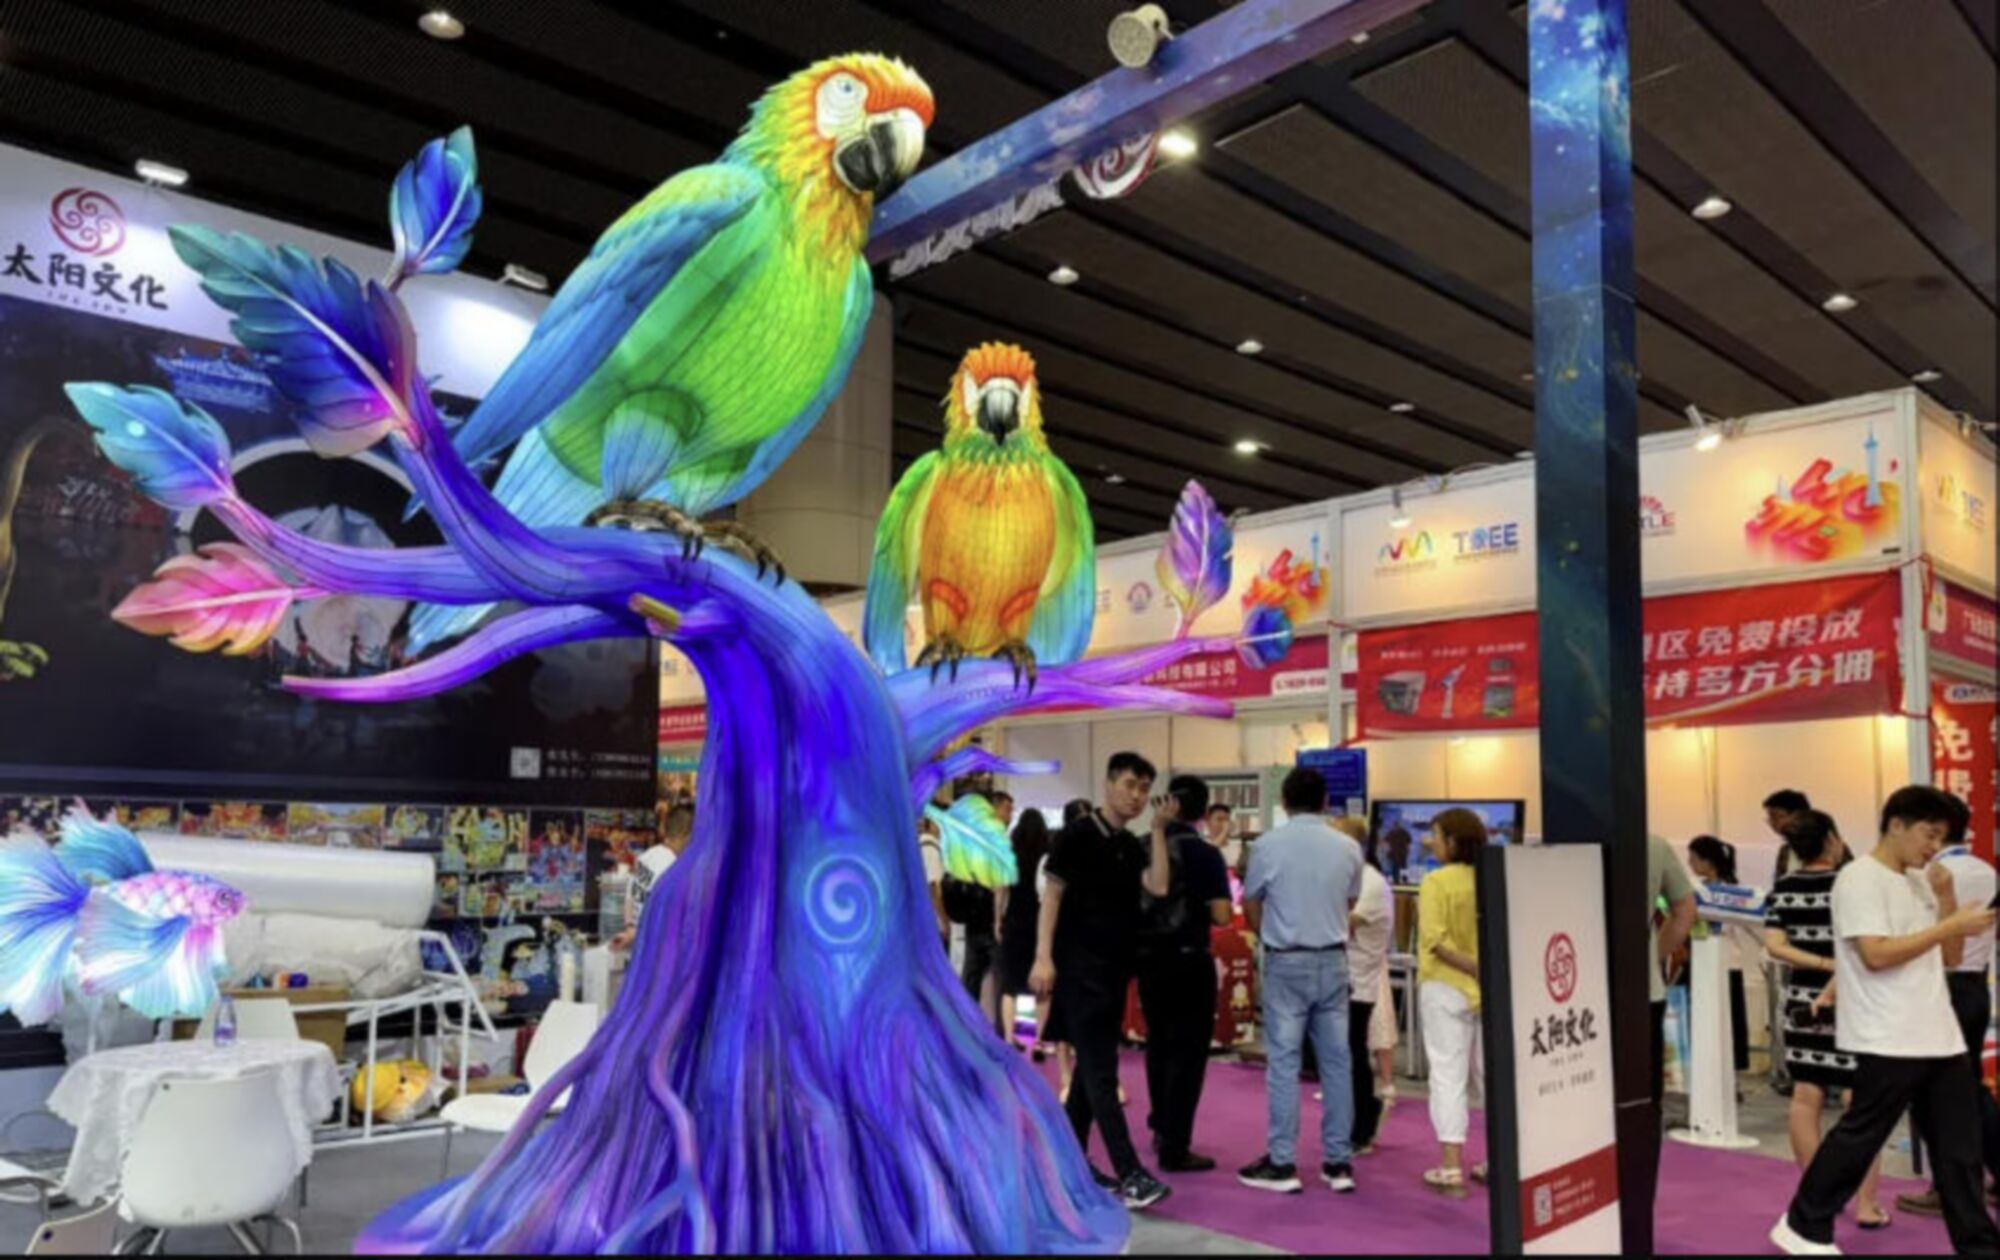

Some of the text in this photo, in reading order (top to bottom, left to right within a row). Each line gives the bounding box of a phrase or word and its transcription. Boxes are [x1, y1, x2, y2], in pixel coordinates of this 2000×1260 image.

[3, 243, 168, 310] 太阳文化
[1643, 608, 1863, 663] 区免费投放
[1643, 648, 1874, 699] 持多方分佣
[1530, 1008, 1597, 1057] 太阳文化
